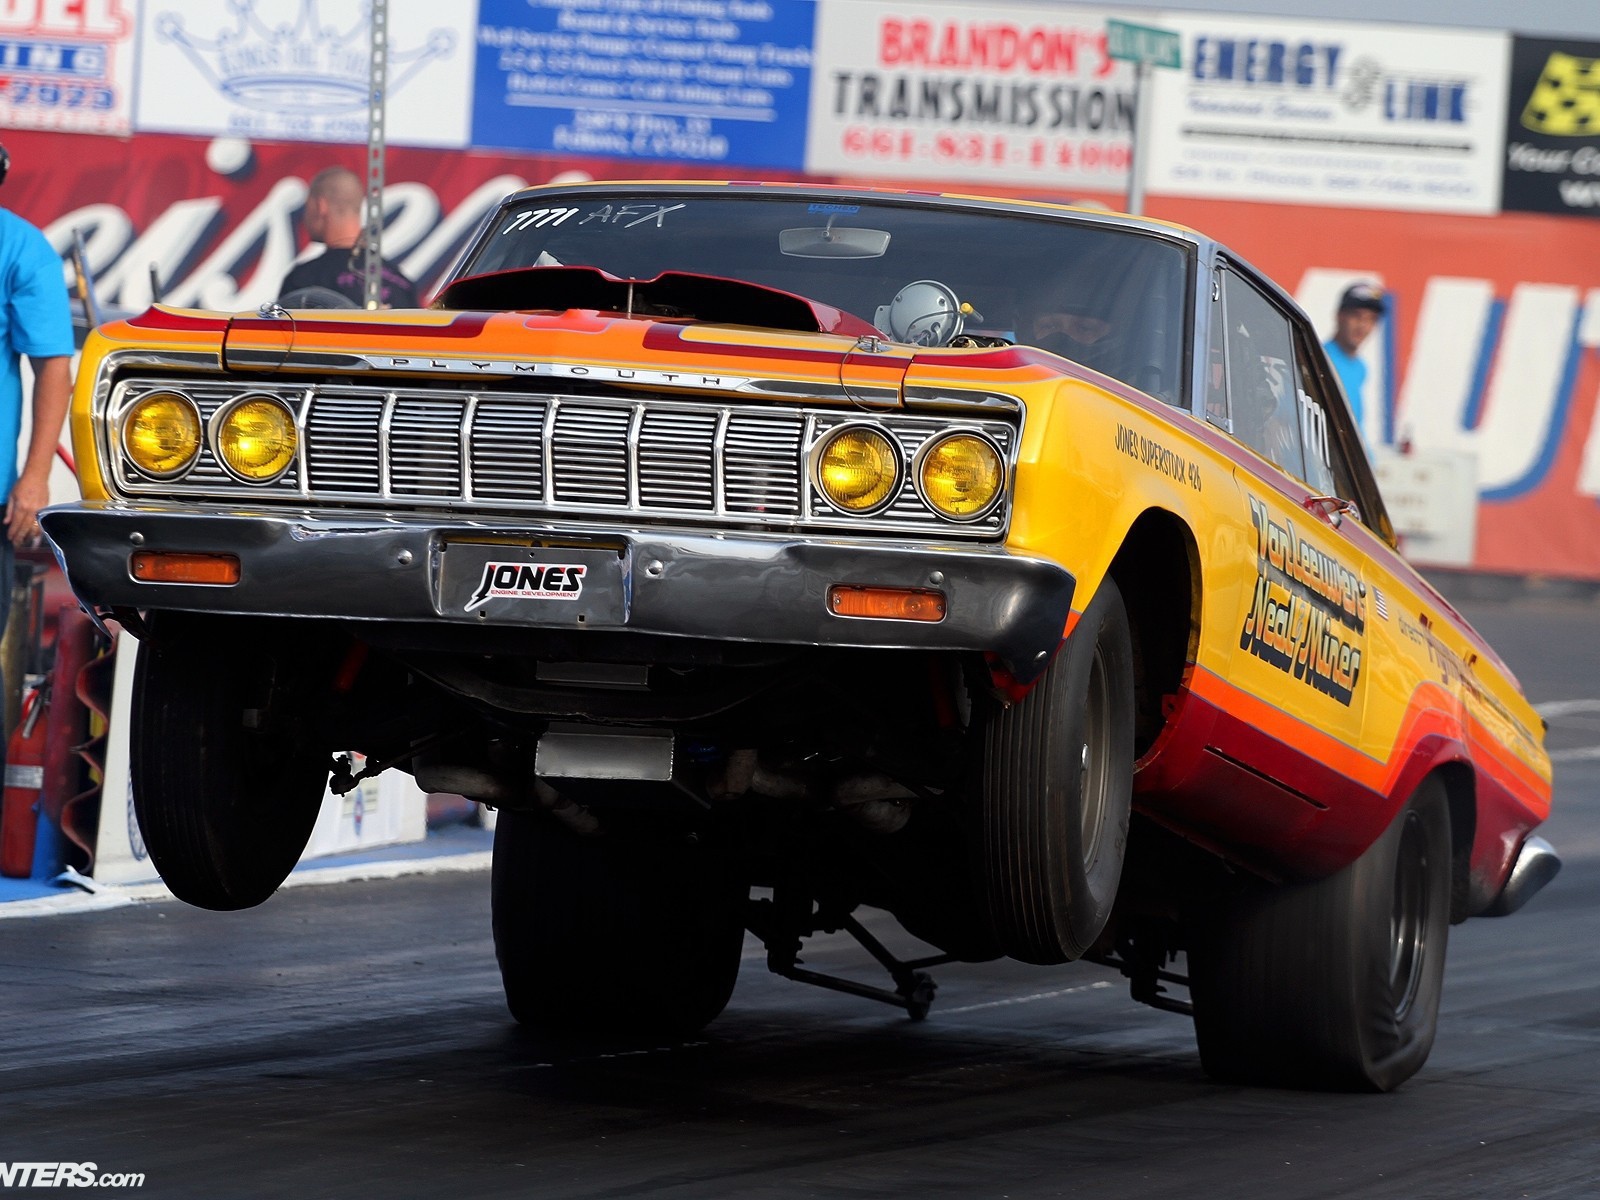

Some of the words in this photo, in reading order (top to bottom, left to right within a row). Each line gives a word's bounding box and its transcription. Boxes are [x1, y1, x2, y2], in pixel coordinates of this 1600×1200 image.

[879, 16, 1116, 79] BRANDON'S
[1190, 33, 1345, 90] ENERGY
[833, 70, 1137, 136] TRANSMISSION
[1382, 78, 1472, 124] LINK
[578, 203, 686, 229] AFX
[389, 357, 722, 386] PLYMOUTH
[1114, 422, 1139, 460] JONES
[1140, 435, 1187, 485] SUPERSTOCK
[1188, 461, 1202, 492] 426
[469, 564, 584, 609] JONES
[490, 589, 519, 597] ENGINE
[521, 590, 577, 598] DEVELOPMENT
[1296, 604, 1361, 700] Miner
